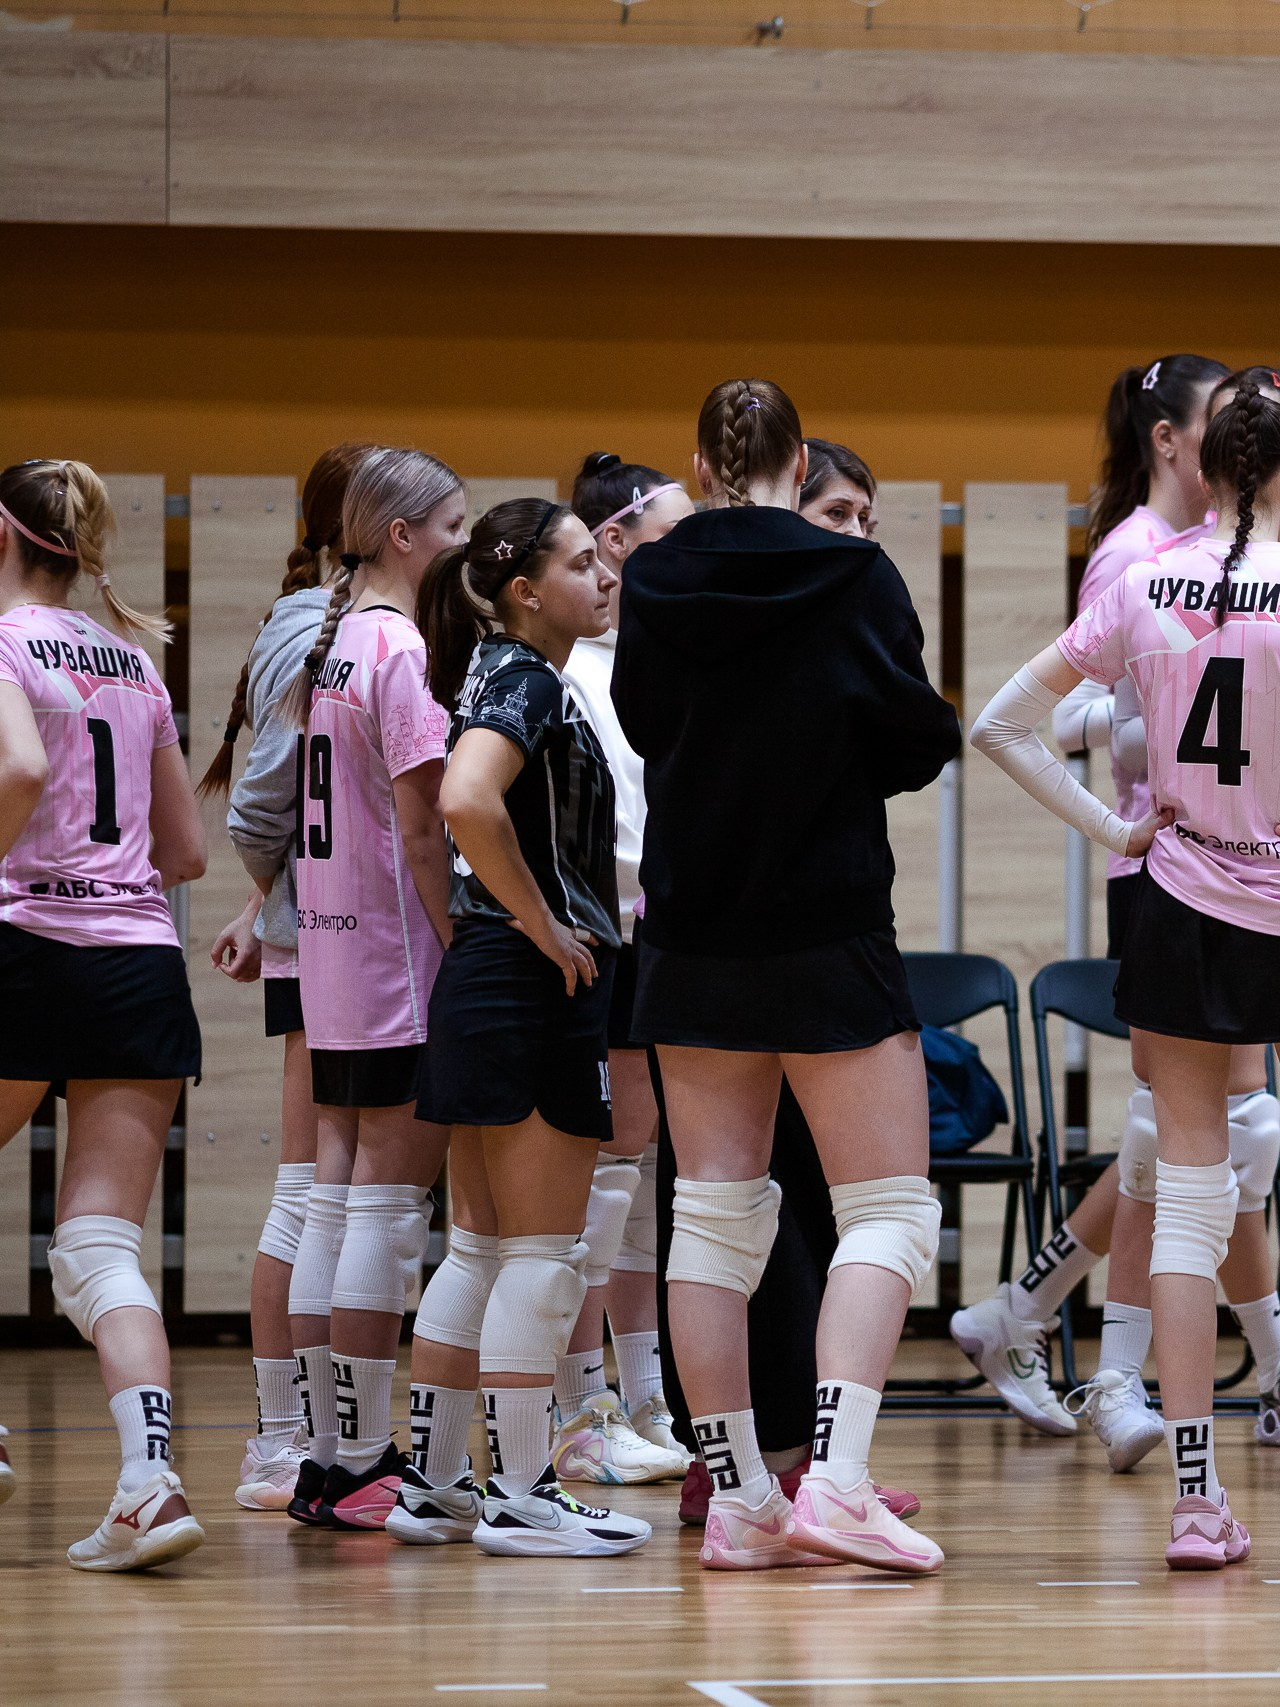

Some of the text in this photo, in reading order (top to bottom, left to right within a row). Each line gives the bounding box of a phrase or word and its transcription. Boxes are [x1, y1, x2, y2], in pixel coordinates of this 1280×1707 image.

[27, 639, 147, 685] ЧУВАШИЯ
[1176, 656, 1251, 787] 4
[87, 717, 122, 845] 1
[55, 879, 105, 899] АБС
[297, 909, 358, 935] БС Электро
[1019, 1227, 1077, 1293] ELITE
[139, 1391, 172, 1462] ELITE
[694, 1420, 741, 1491] ELITE
[813, 1386, 842, 1462] ELITE
